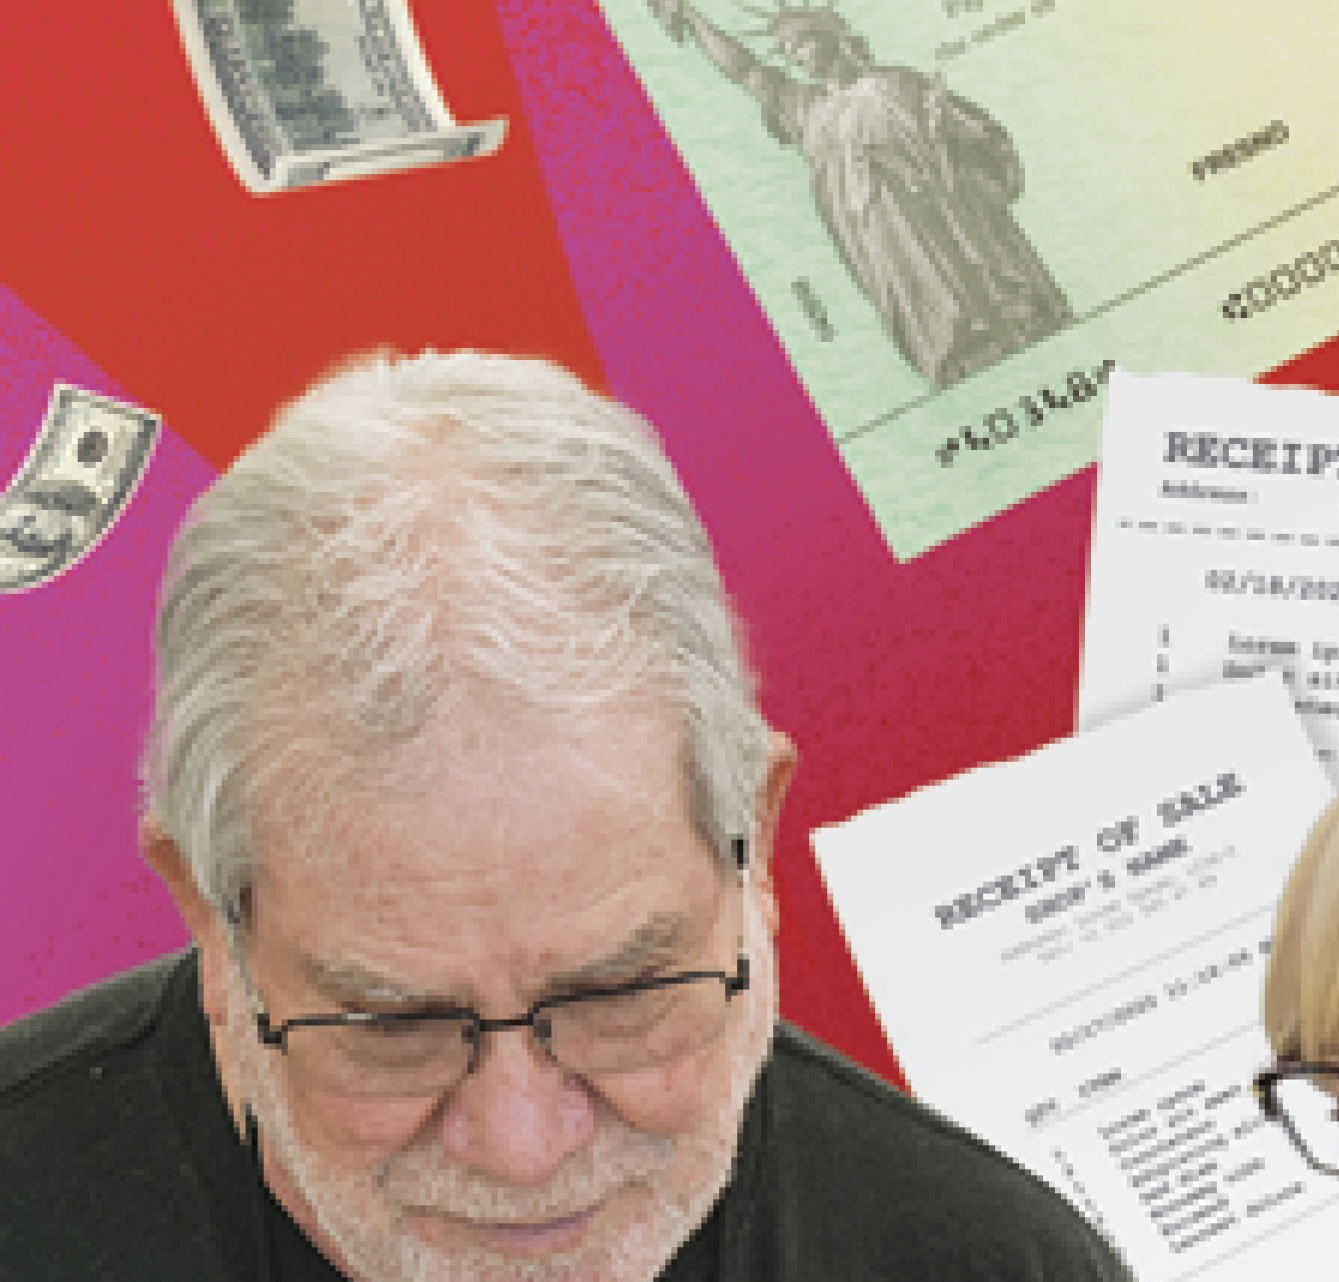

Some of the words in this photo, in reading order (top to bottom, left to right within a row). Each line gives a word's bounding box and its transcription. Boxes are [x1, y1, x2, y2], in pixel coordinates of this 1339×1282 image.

[933, 844, 1081, 931] RECEIPT
[1095, 815, 1141, 854] OF
[1155, 770, 1247, 828] SALE
